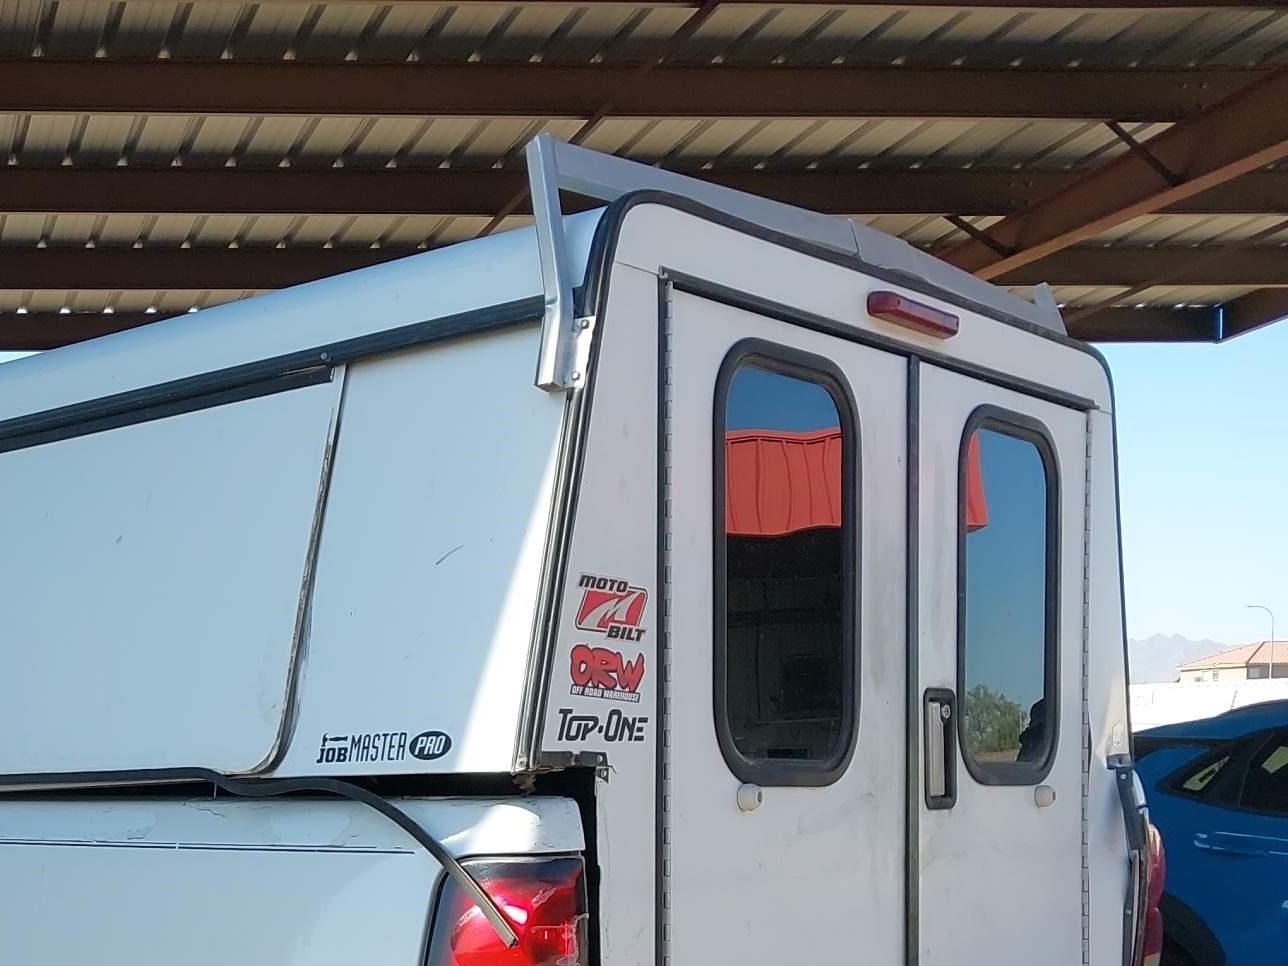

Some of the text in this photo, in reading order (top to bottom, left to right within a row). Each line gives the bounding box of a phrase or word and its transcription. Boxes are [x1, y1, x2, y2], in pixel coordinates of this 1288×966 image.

[579, 575, 628, 593] MOTO
[607, 625, 645, 641] BILT
[570, 644, 645, 692] ORW
[584, 687, 602, 698] ROAD
[414, 735, 447, 755] PRO
